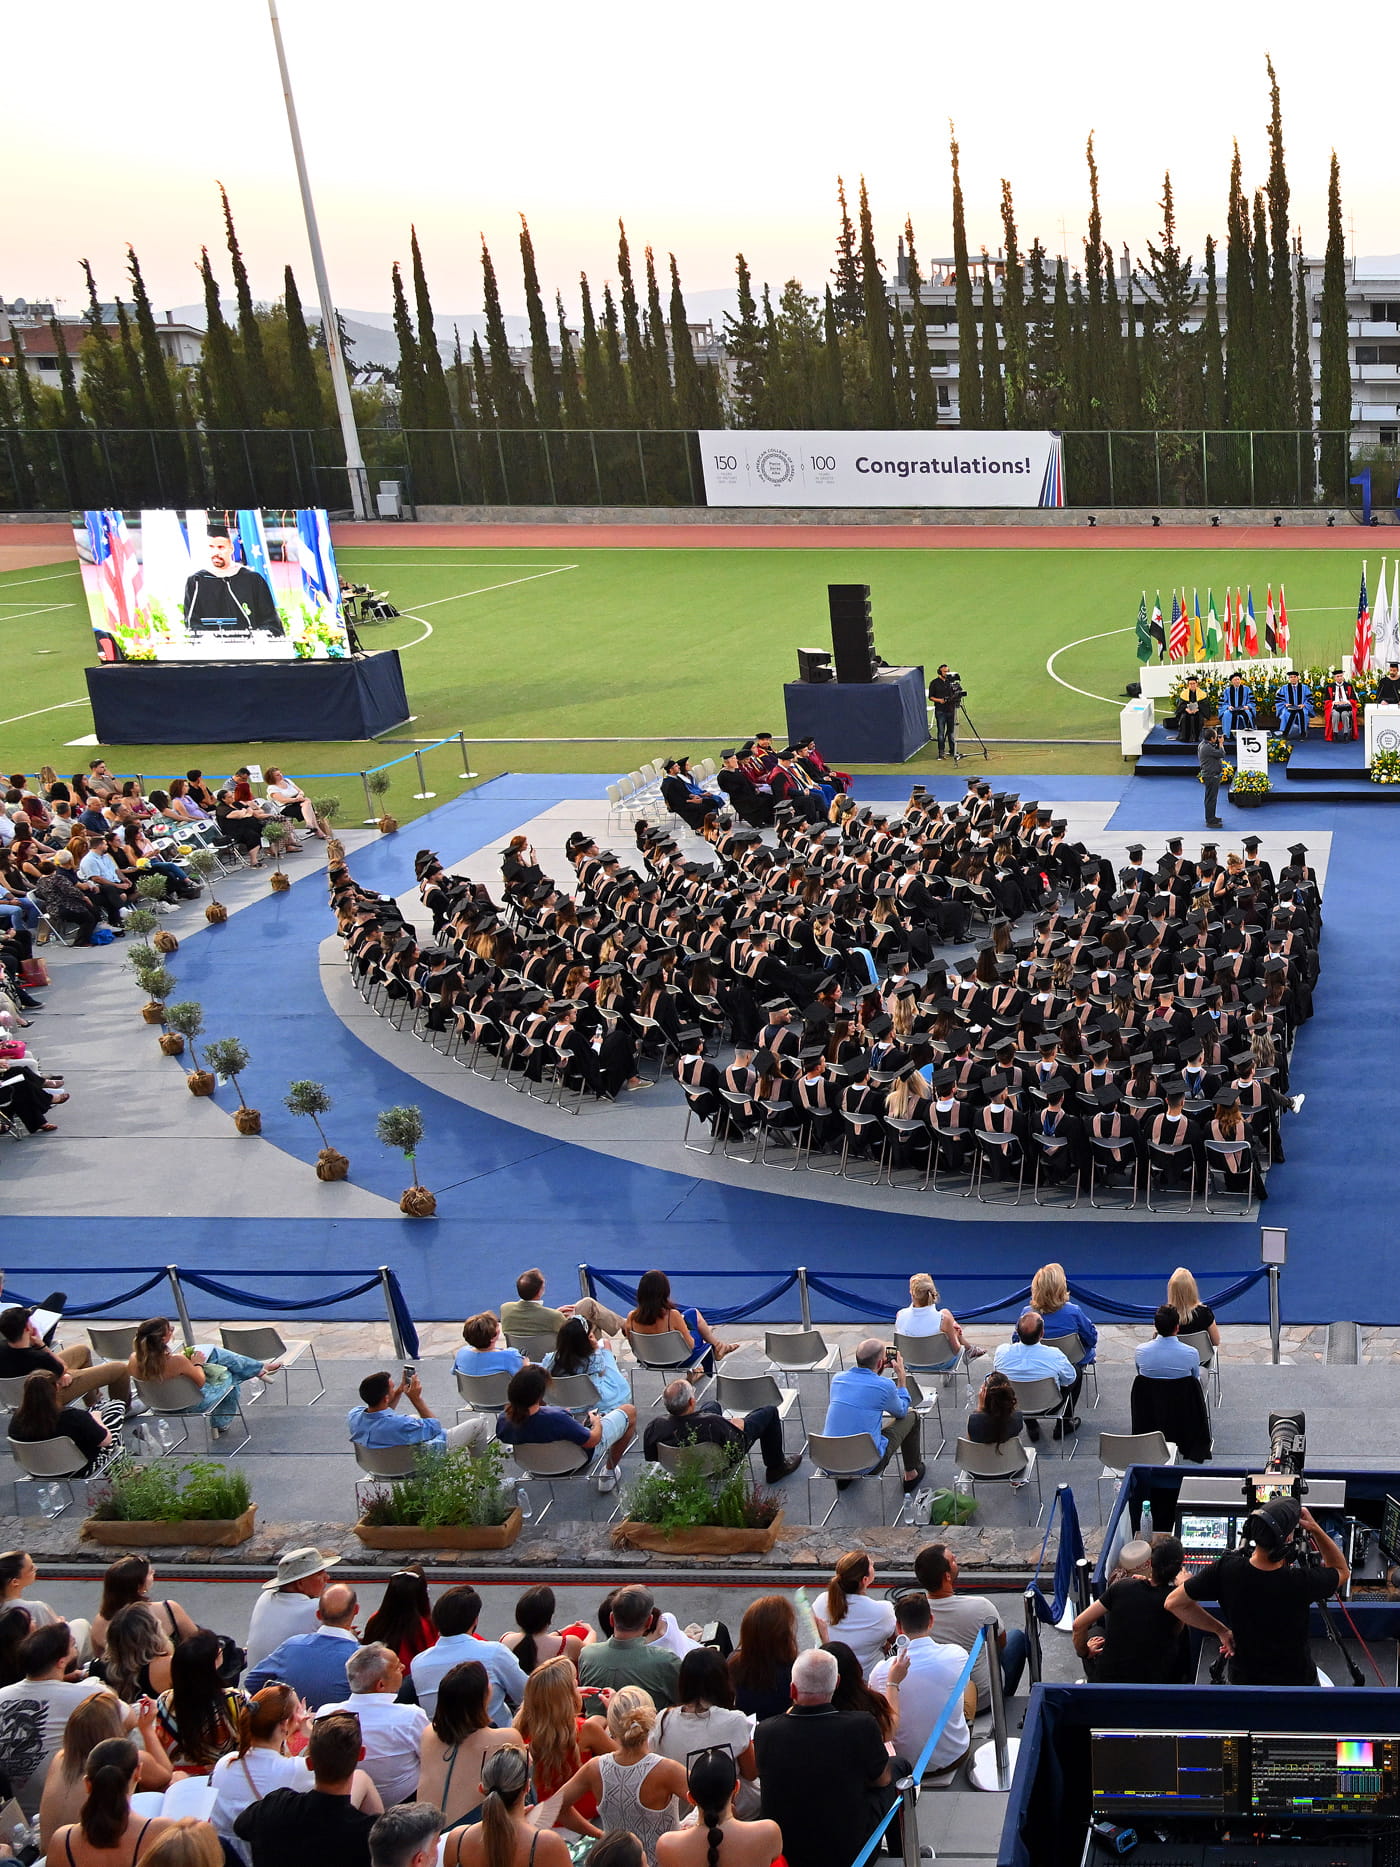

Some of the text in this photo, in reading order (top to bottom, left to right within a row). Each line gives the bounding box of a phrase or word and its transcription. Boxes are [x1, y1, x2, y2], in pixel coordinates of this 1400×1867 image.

[713, 455, 738, 471] 150
[810, 455, 836, 471] 100
[855, 456, 1031, 477] Congratulations!
